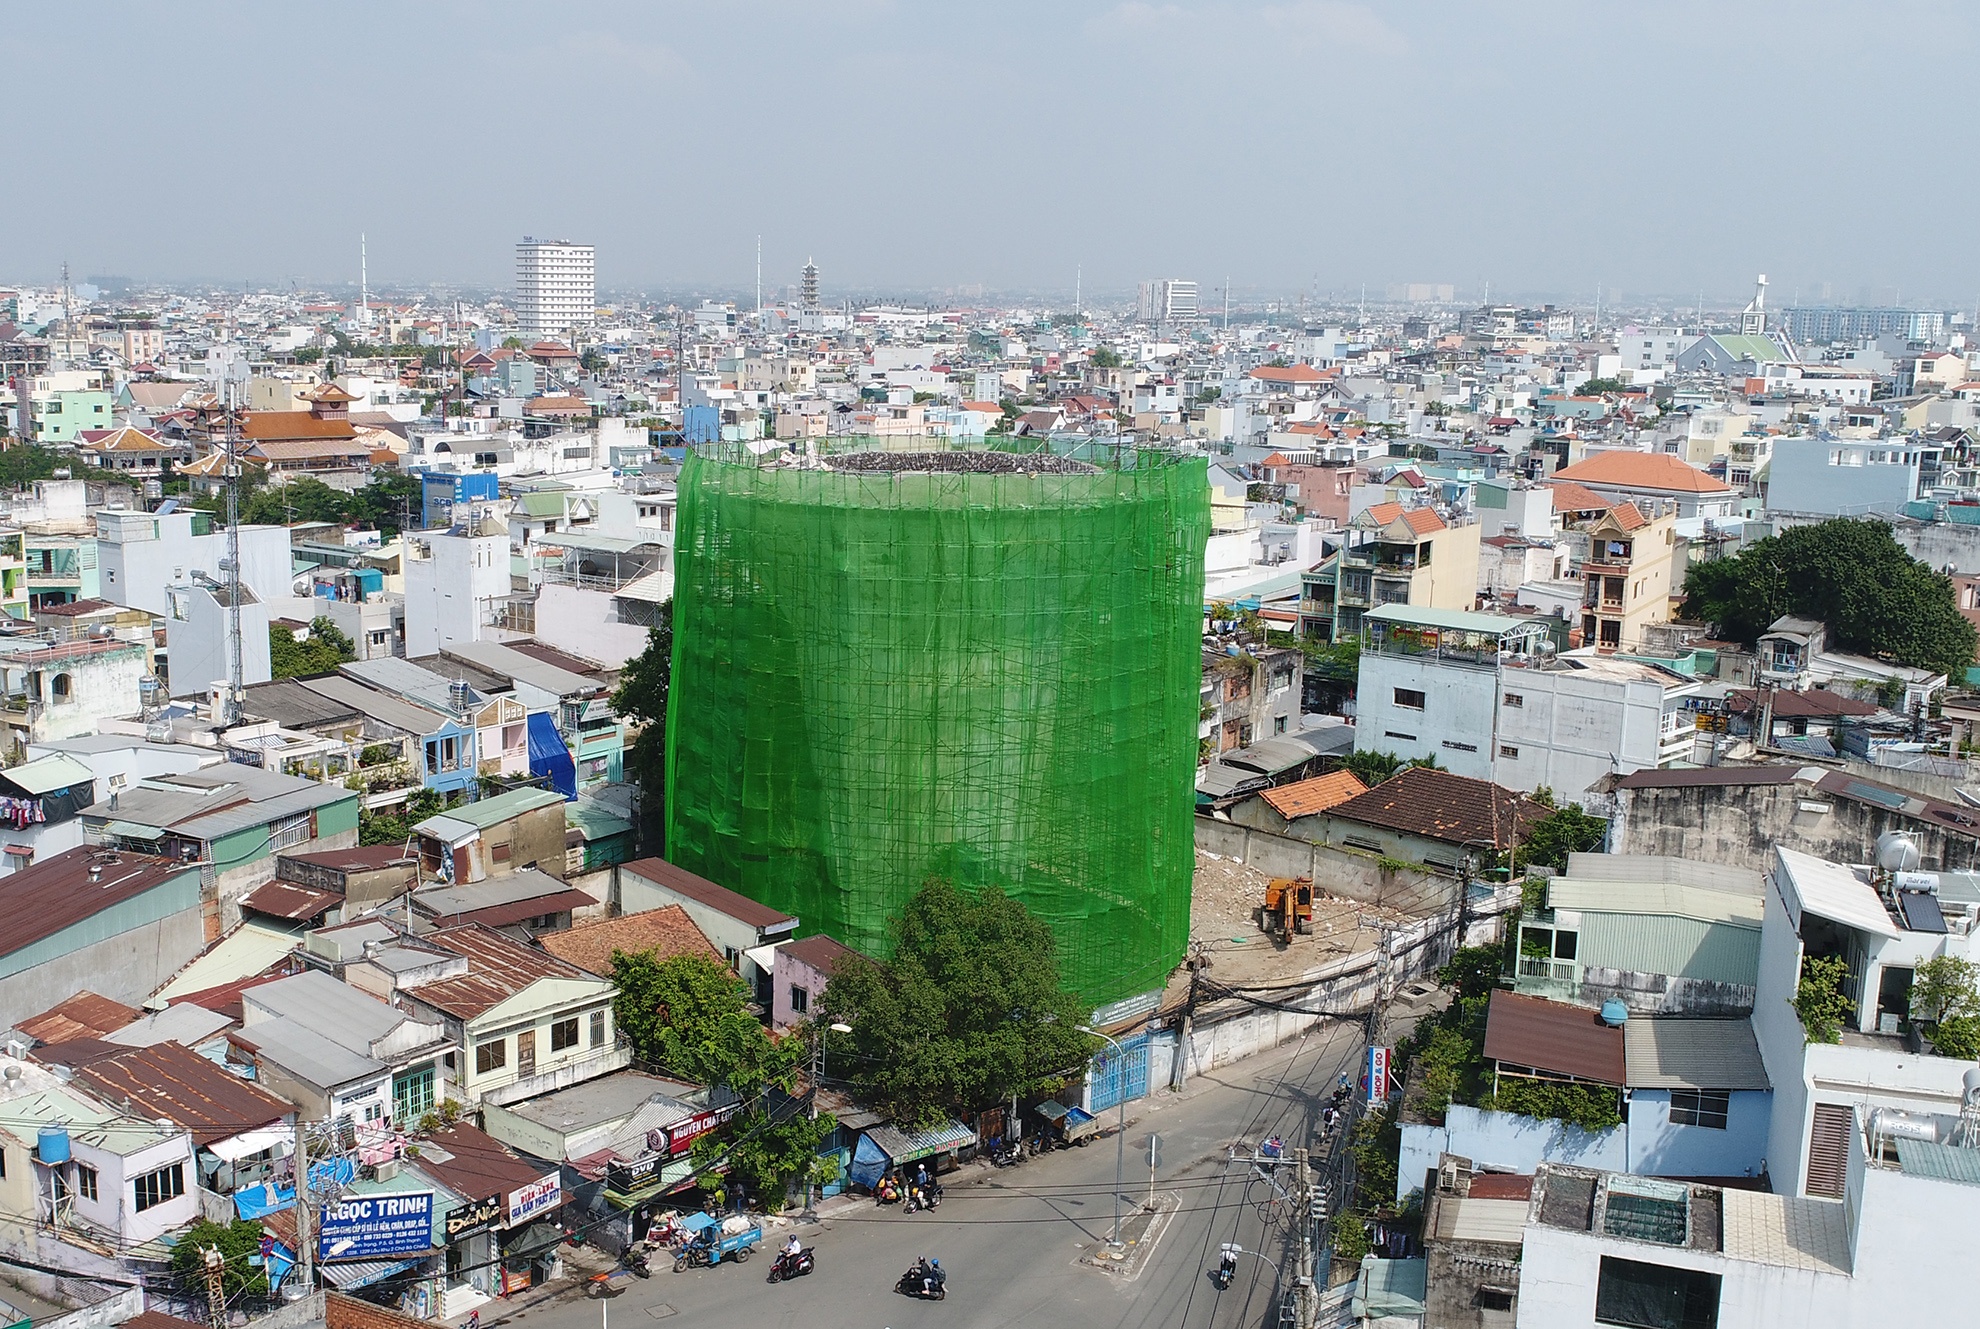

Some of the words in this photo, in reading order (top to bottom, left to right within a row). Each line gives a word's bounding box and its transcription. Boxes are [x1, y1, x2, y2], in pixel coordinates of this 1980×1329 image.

[433, 497, 452, 507] SCB
[1375, 1052, 1383, 1067] GO
[1375, 1067, 1383, 1075] &
[1374, 1075, 1383, 1098] SHOP
[631, 1162, 655, 1177] DVD
[326, 1200, 372, 1222] NGỌC
[376, 1196, 427, 1216] TRINH
